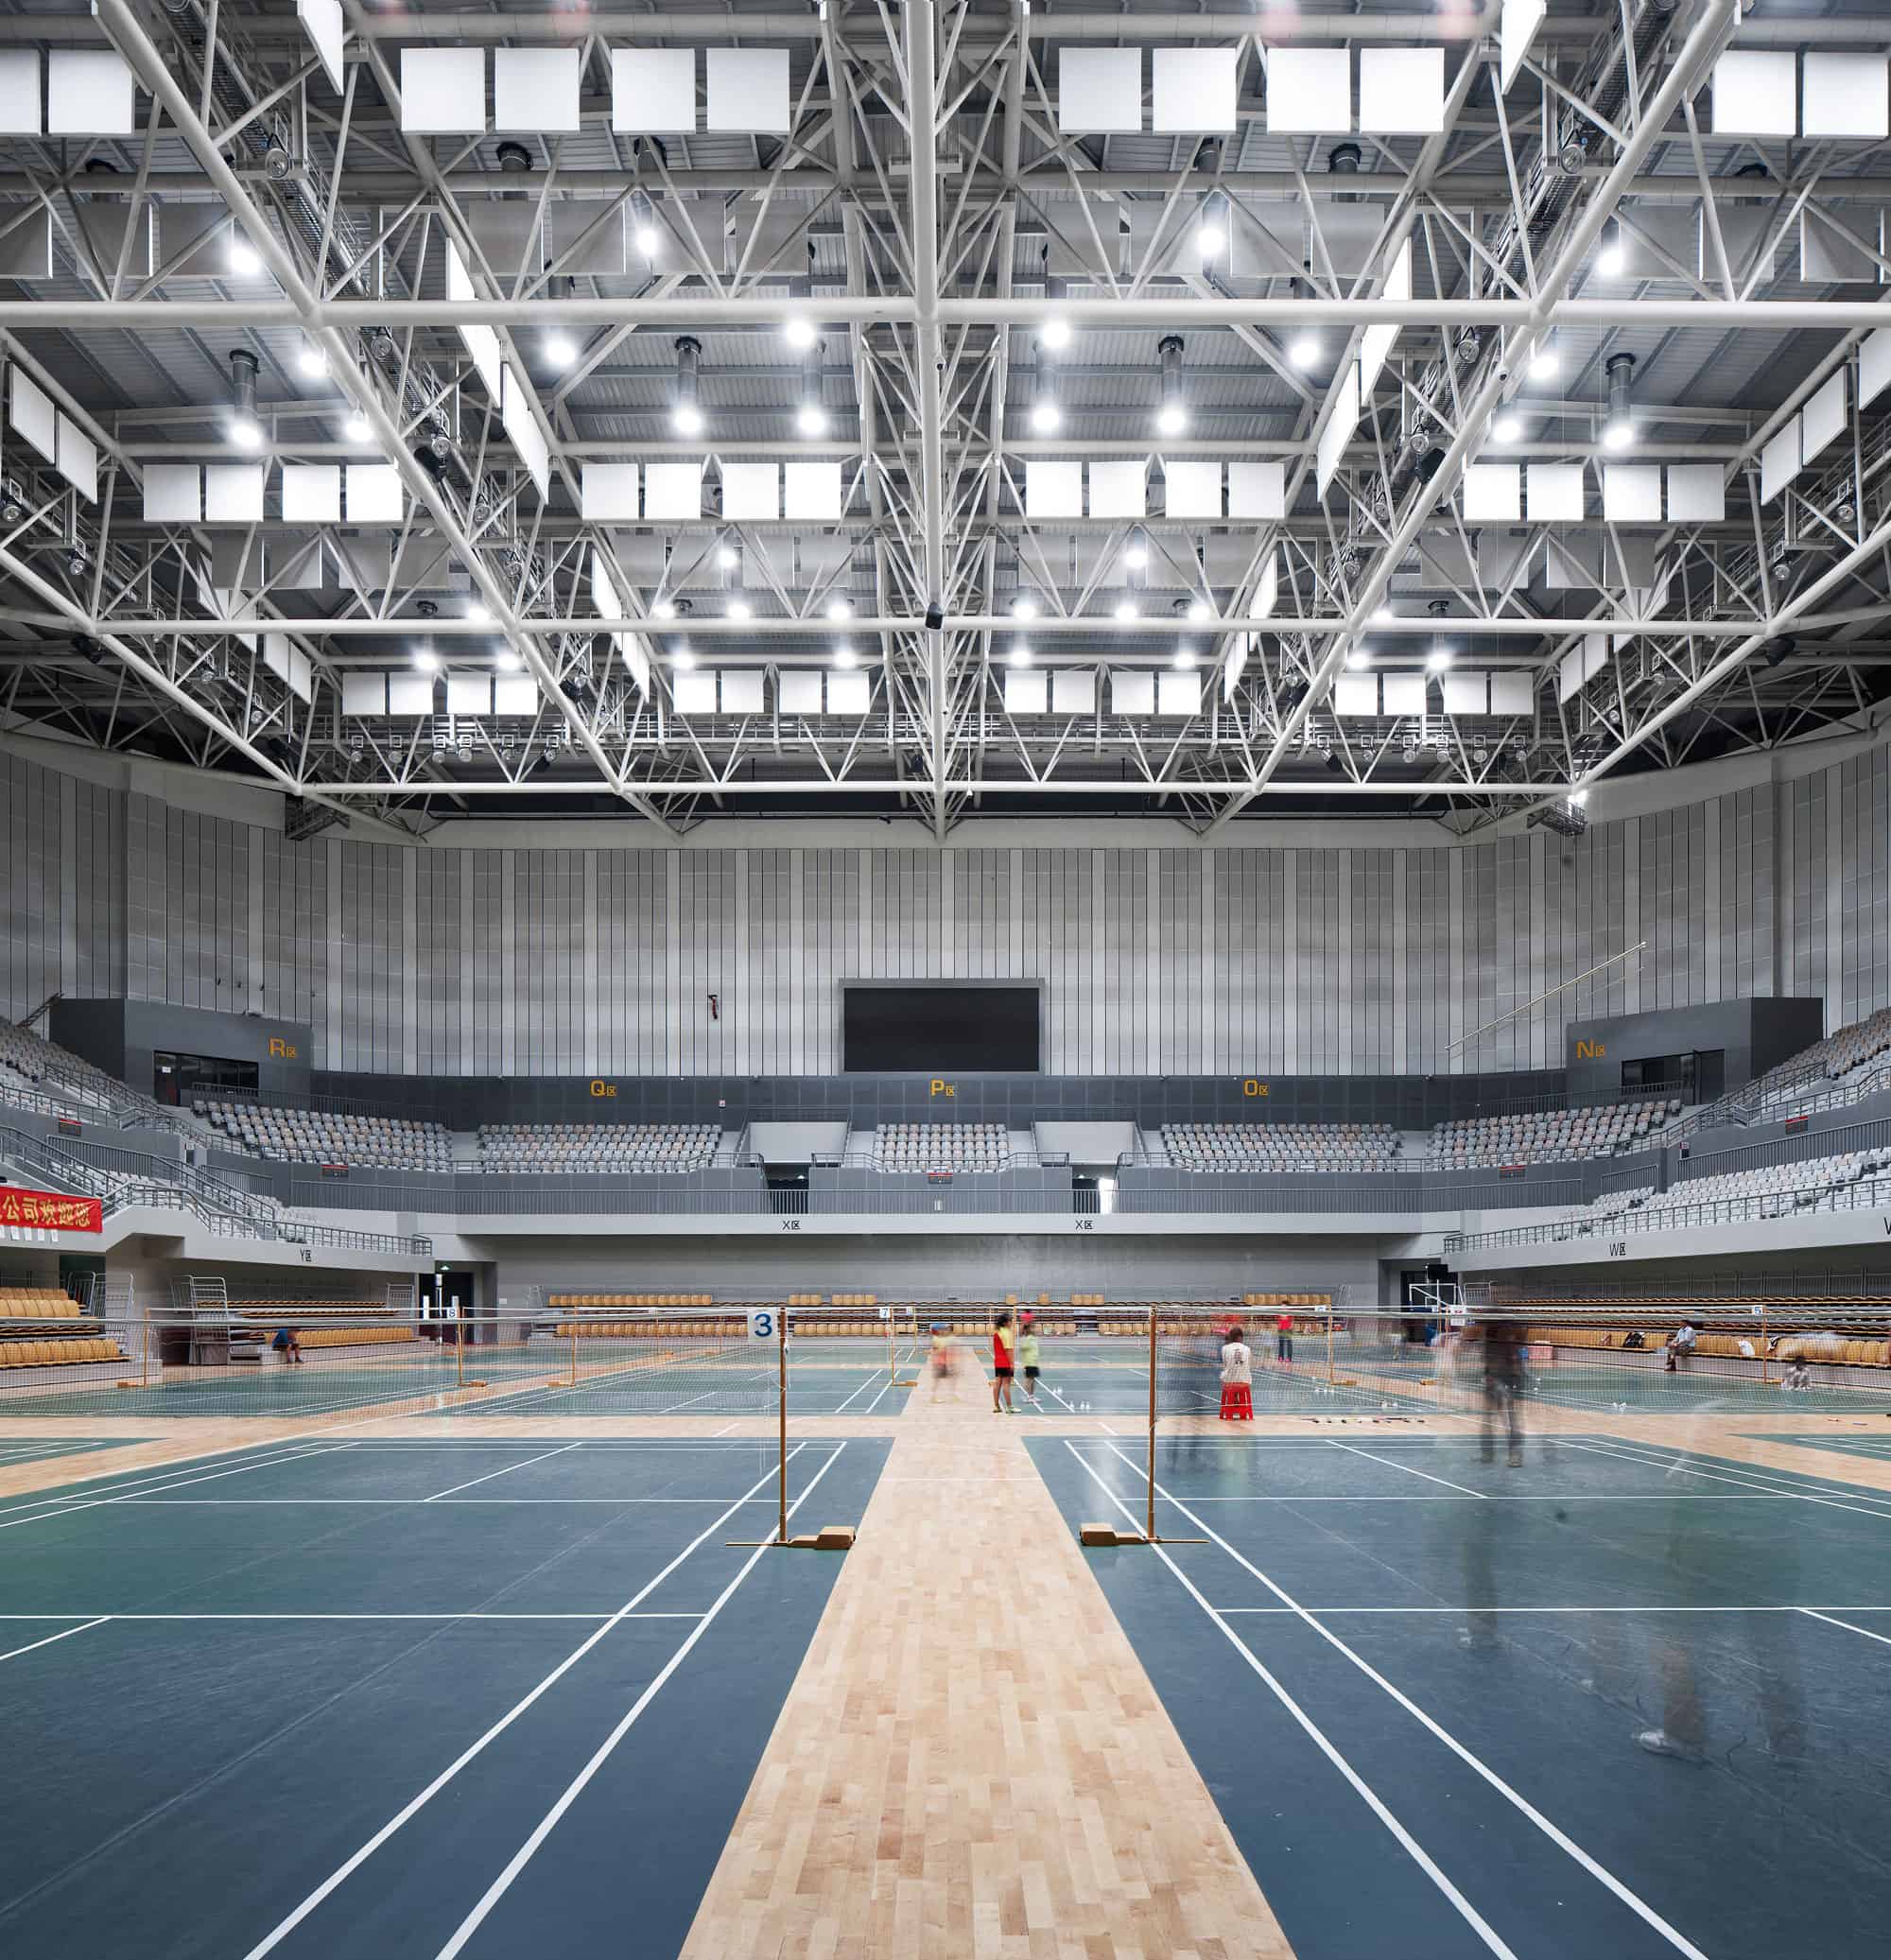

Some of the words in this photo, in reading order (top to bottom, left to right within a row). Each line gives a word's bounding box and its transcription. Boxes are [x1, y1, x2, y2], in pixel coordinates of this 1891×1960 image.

[269, 1037, 296, 1059] R区
[1576, 1039, 1605, 1059] N区
[590, 1080, 617, 1097] Q区
[930, 1080, 957, 1097] P区
[0, 1194, 91, 1227] 公司欢迎您
[782, 1220, 802, 1230] X区
[1075, 1220, 1094, 1230] X区
[299, 1248, 312, 1262] Y区
[1609, 1241, 1626, 1257] W区
[755, 1313, 772, 1337] 3
